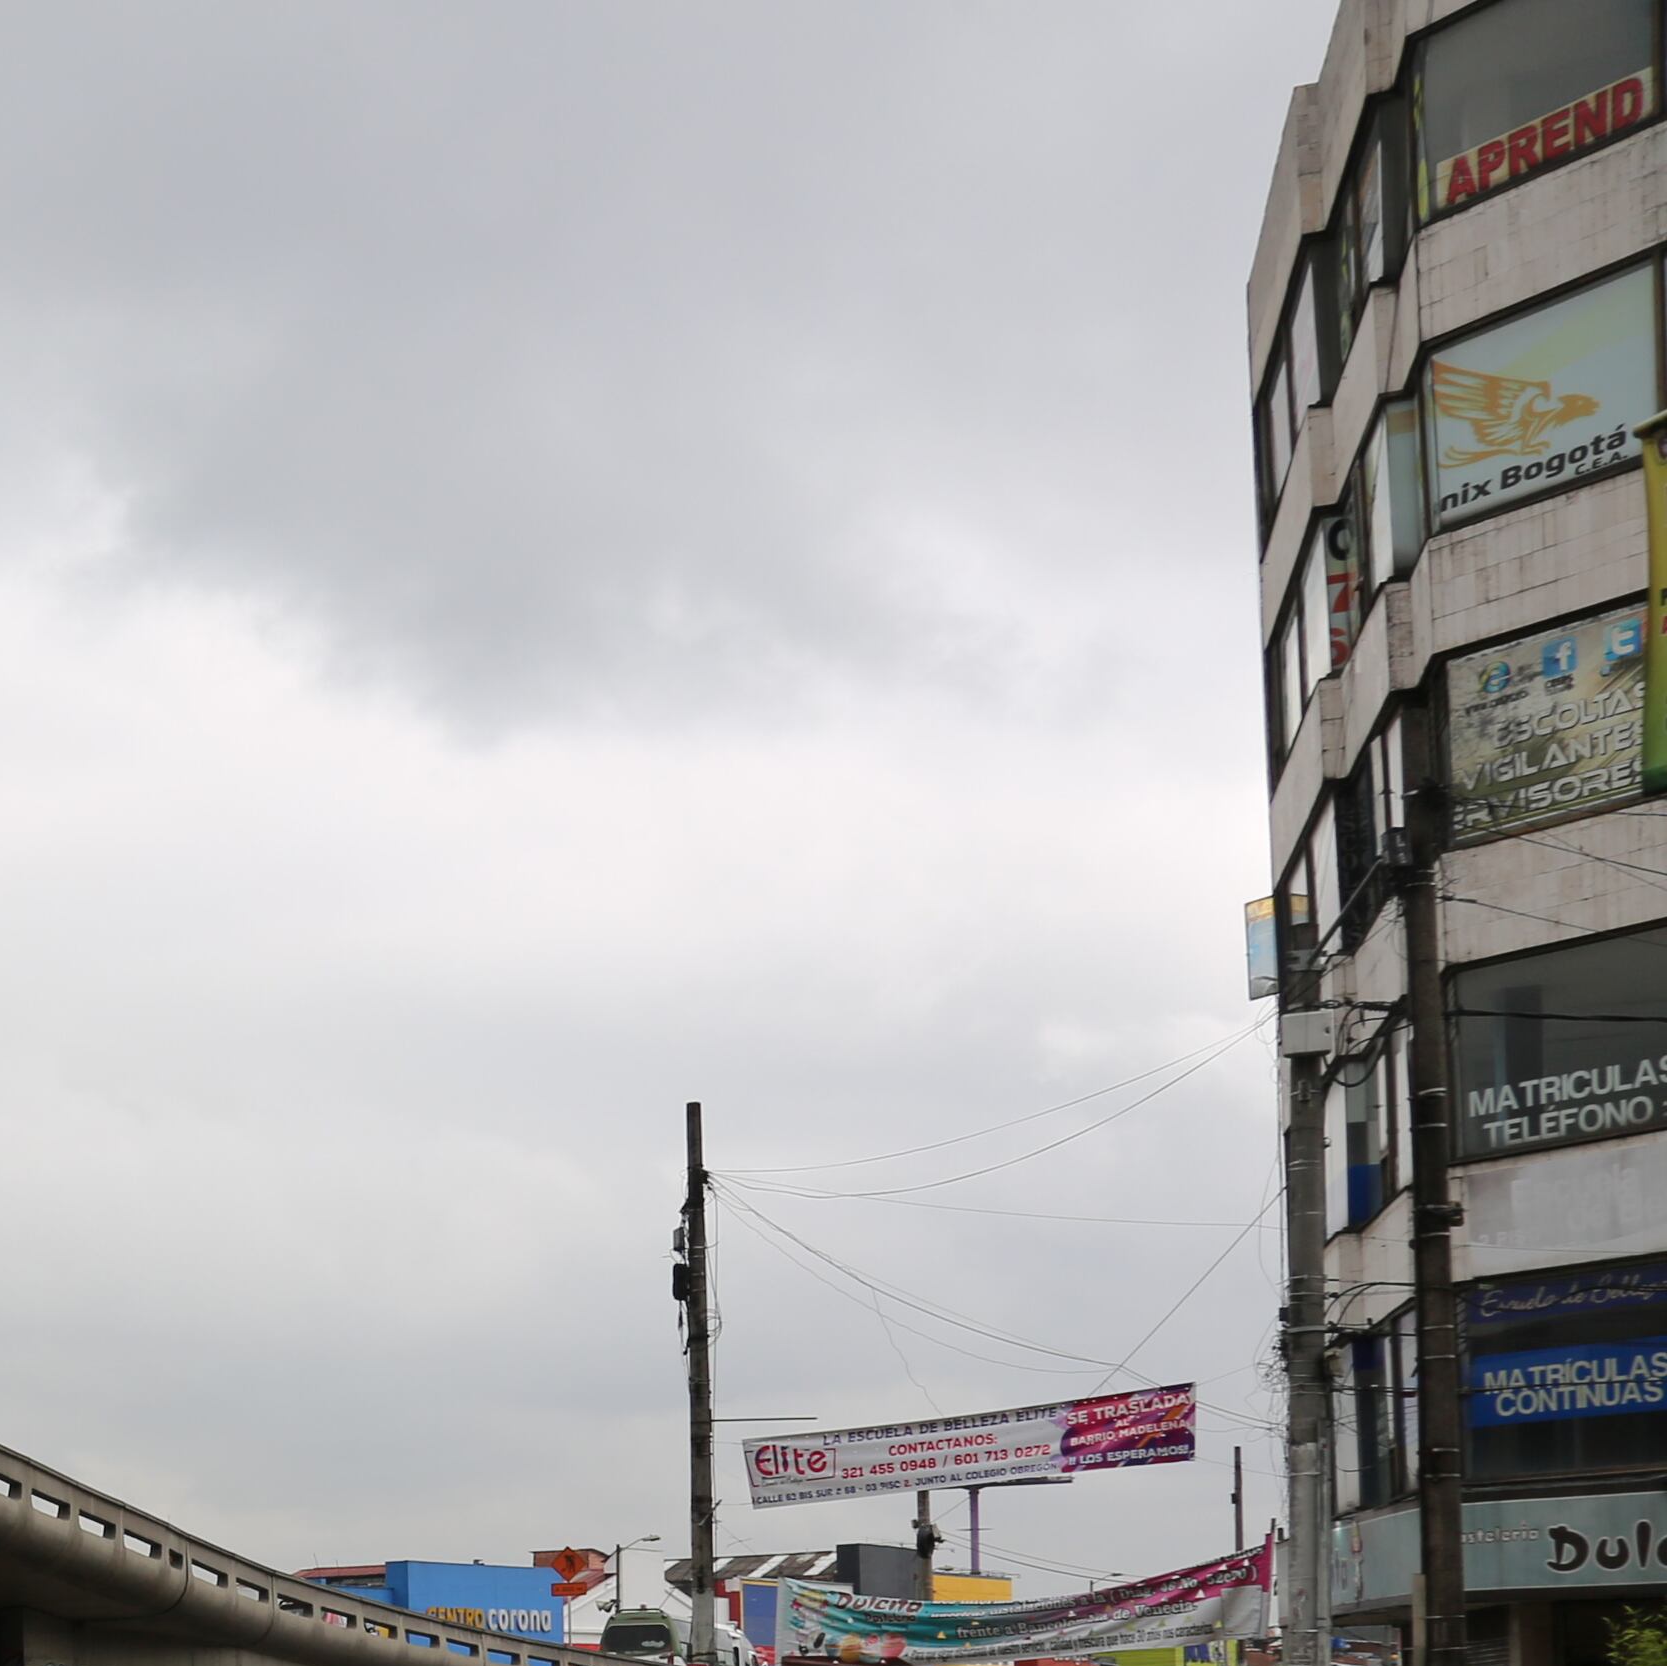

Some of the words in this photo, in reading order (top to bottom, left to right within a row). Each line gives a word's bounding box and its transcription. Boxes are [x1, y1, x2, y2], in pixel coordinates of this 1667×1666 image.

[1446, 77, 1644, 205] APREND
[1499, 423, 1628, 490] Bogotá
[1482, 1096, 1654, 1148] TELÉFONO
[1067, 1411, 1088, 1426] SE
[1095, 1392, 1192, 1419] TRASLADA
[1495, 1377, 1664, 1417] CONTINUAS
[822, 1433, 842, 1446] LA
[847, 1426, 914, 1444] ESCUELA
[918, 1422, 939, 1435] DE
[943, 1412, 1010, 1432] BELLEZA
[1069, 1432, 1116, 1447] BARRIO
[754, 1445, 828, 1477] Elite
[841, 1467, 865, 1480] 321
[869, 1462, 895, 1476] 455
[899, 1457, 938, 1473] 0948
[953, 1454, 980, 1467] 601
[985, 1448, 1009, 1461] 713
[1014, 1443, 1052, 1459] 0272
[1078, 1453, 1104, 1465] LOS
[756, 1493, 784, 1505] CALLE
[914, 1475, 948, 1487] JUNTO
[949, 1473, 964, 1484] AL
[964, 1468, 1008, 1481] COLEGIO
[487, 1607, 552, 1633] corona
[956, 1622, 1000, 1639] frente
